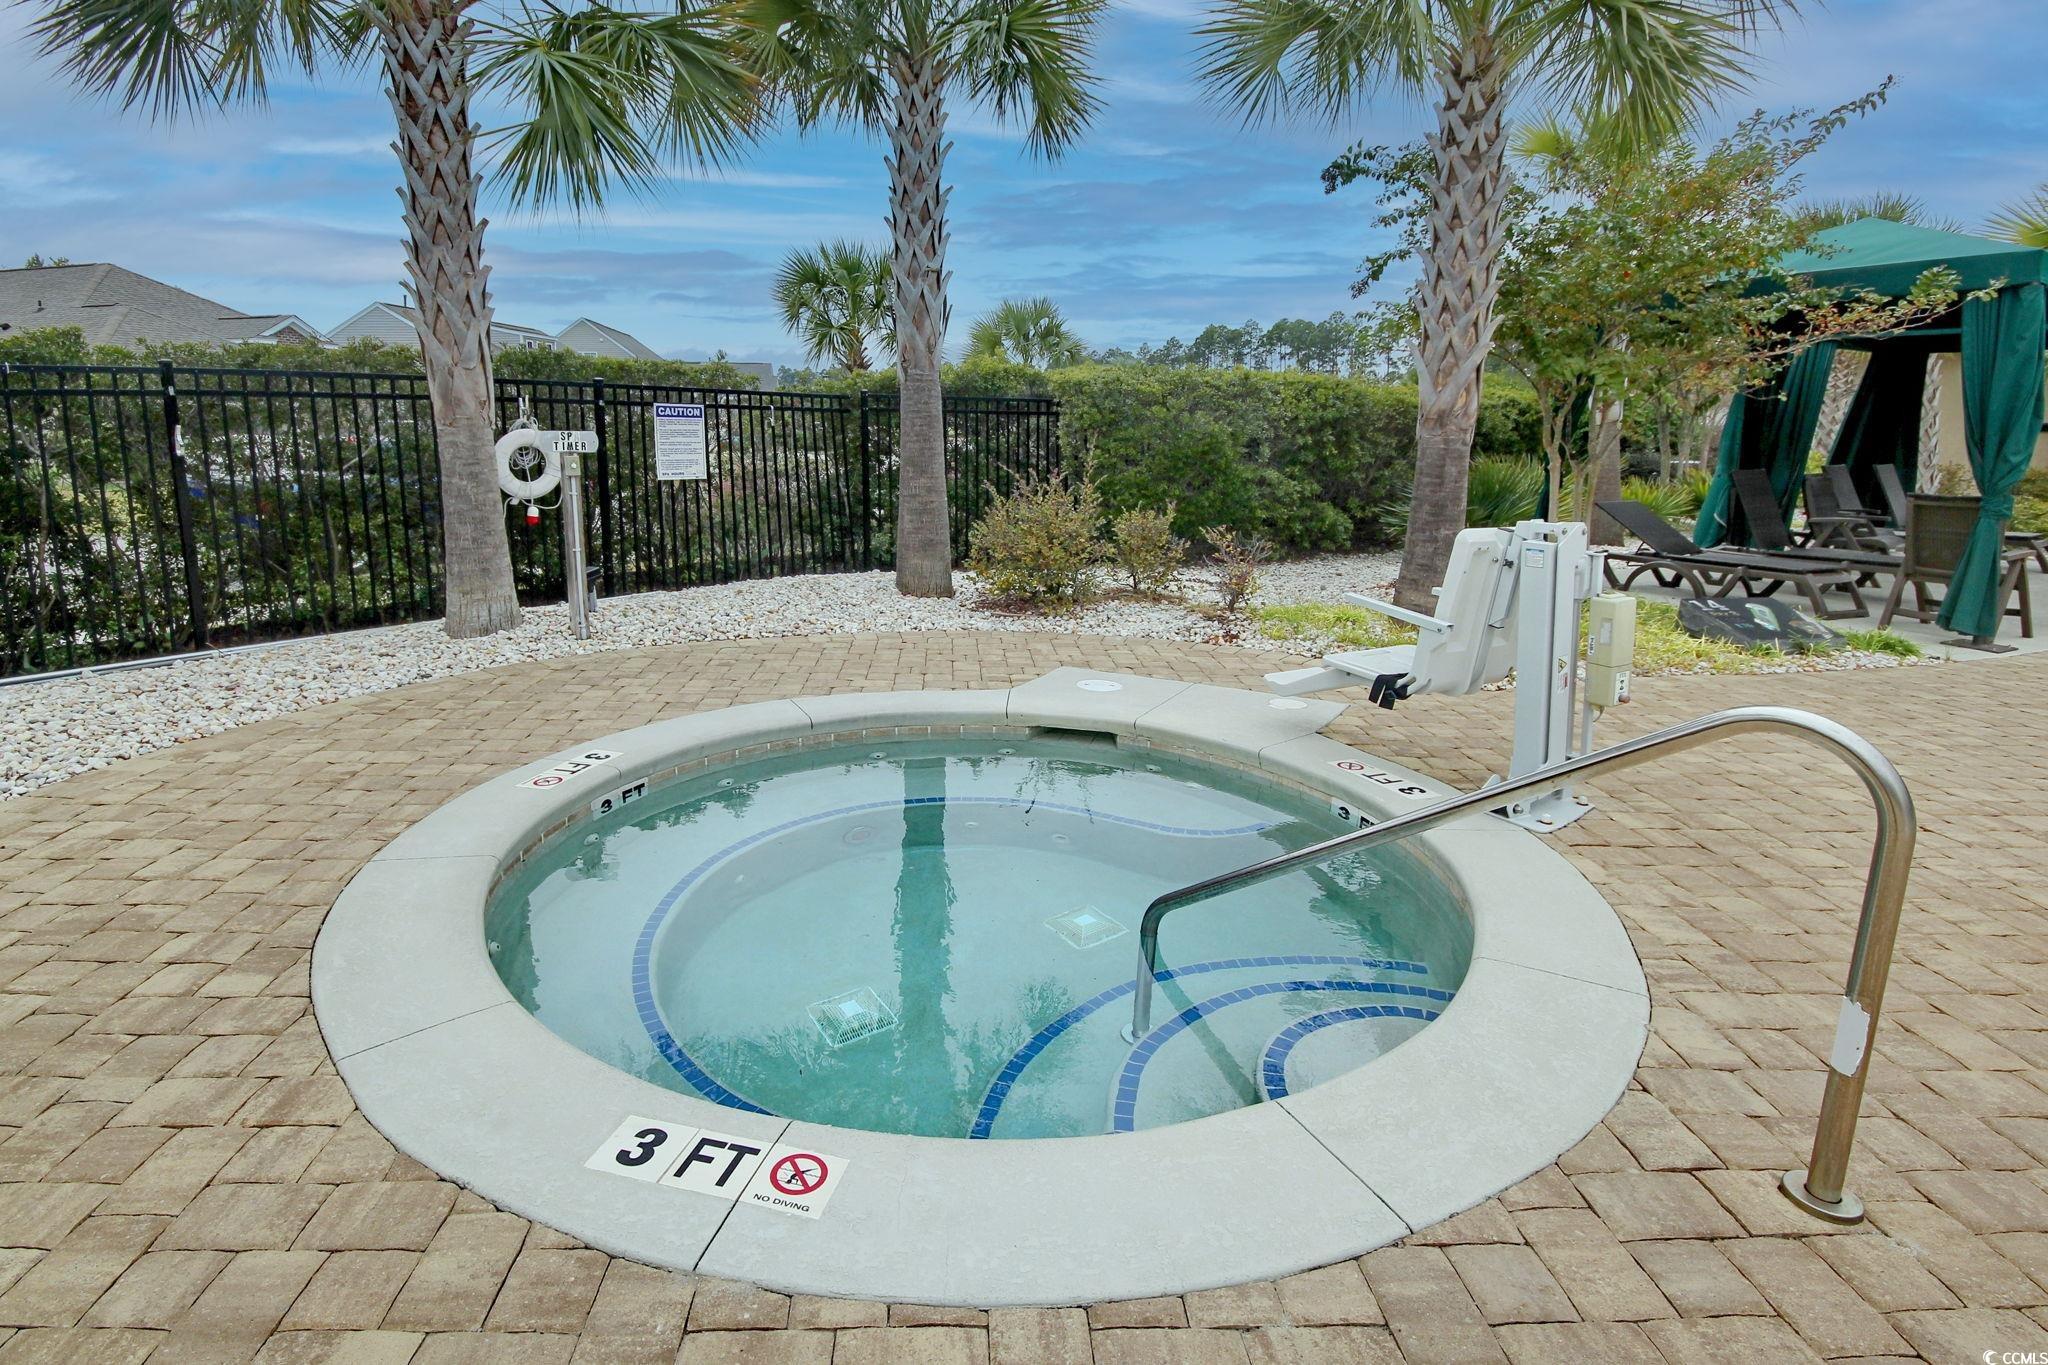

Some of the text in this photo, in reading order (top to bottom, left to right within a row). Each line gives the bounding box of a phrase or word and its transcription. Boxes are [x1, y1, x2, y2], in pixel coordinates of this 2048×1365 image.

[658, 407, 701, 417] CAUTION
[554, 442, 587, 451] TIMER
[560, 432, 573, 441] SP
[554, 752, 611, 775] 3 FT
[1362, 772, 1427, 795] 3 FT
[600, 782, 646, 814] 3 FT
[1337, 806, 1377, 829] 3 F
[615, 1127, 761, 1187] 3 FT
[753, 1193, 810, 1213] NO DIVING
